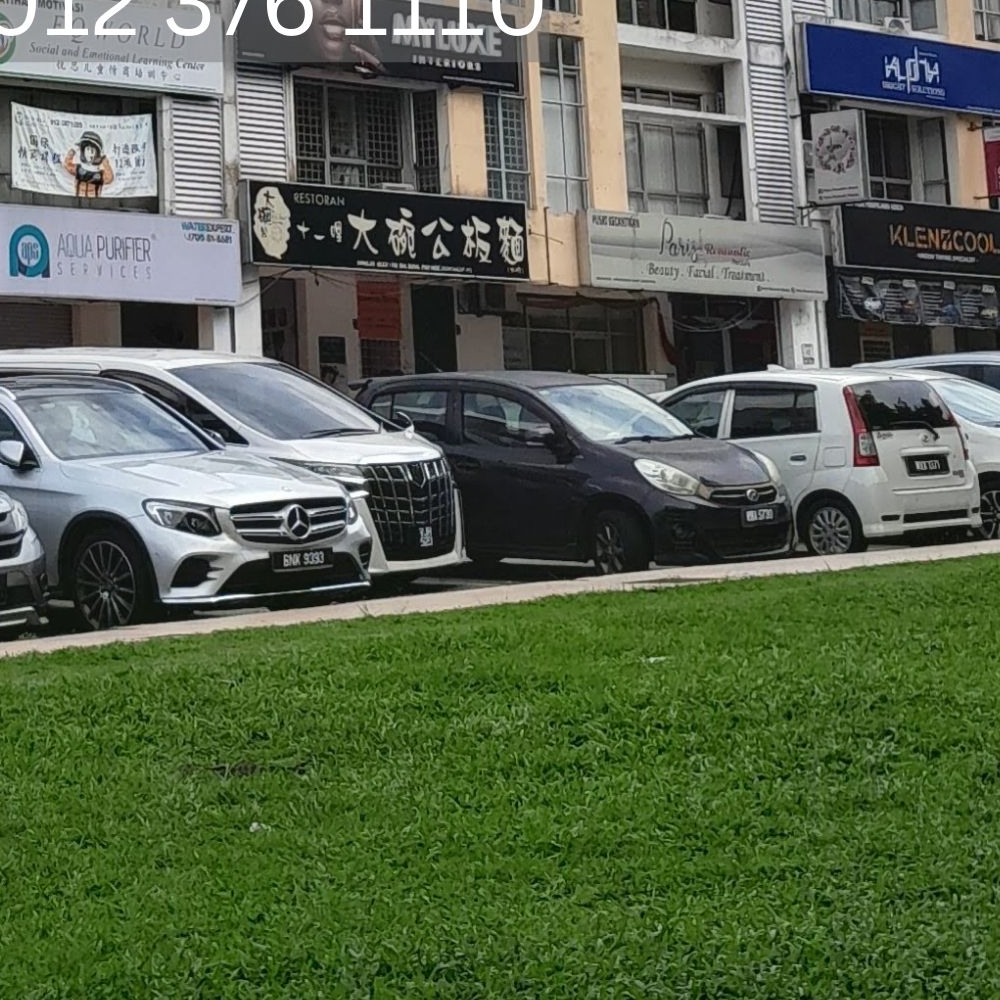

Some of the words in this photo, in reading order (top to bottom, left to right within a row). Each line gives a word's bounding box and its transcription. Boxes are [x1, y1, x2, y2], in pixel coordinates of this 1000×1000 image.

[29, 41, 59, 56] Social
[61, 46, 80, 57] and
[82, 47, 130, 62] Emotional
[132, 56, 173, 70] Learning
[293, 192, 345, 206] RESTORAN
[57, 232, 94, 260] AQUA
[96, 235, 151, 262] PURIFIER
[57, 262, 152, 280] SERVICES
[648, 263, 680, 281] Beauty
[688, 265, 715, 279] Facial
